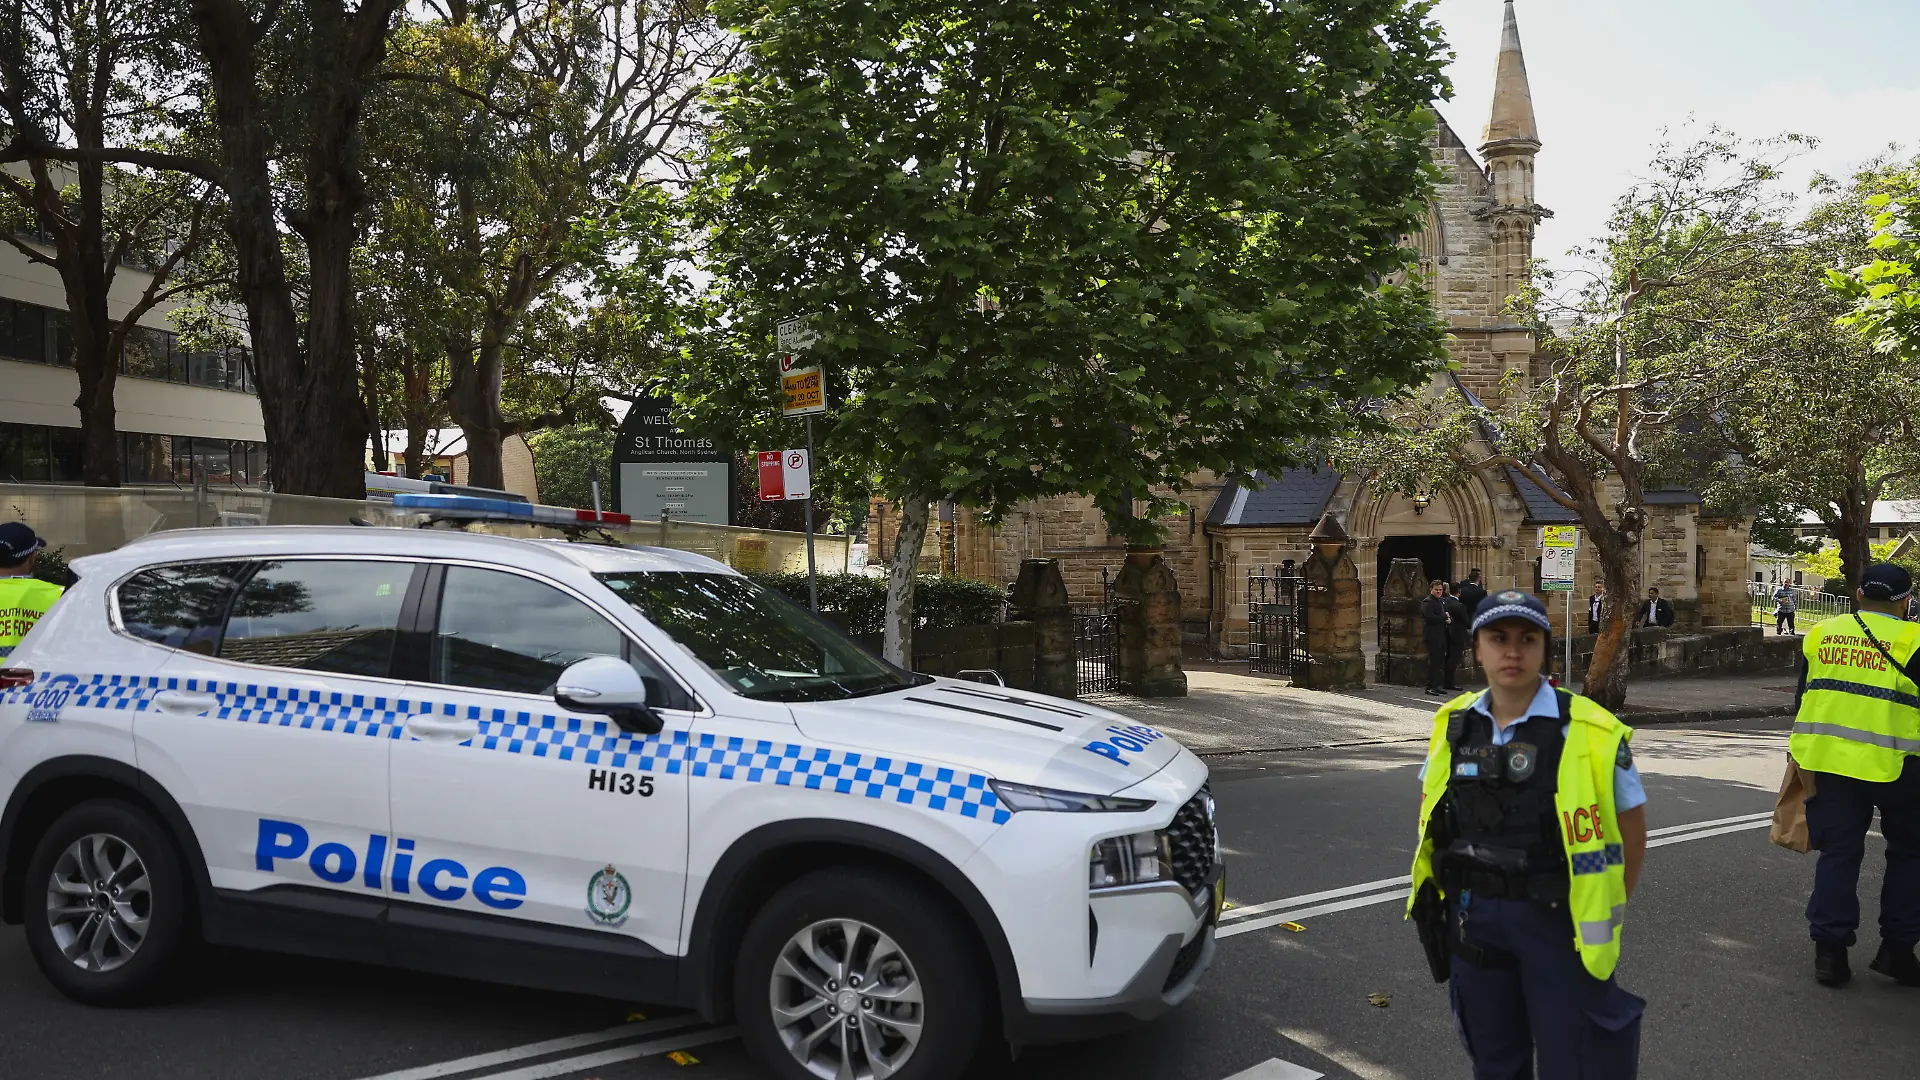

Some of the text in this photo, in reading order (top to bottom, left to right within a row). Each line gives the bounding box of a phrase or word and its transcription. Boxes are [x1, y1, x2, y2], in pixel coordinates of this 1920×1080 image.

[798, 393, 805, 401] 20
[807, 390, 820, 400] OCT
[635, 436, 713, 448] St Thomas
[1833, 634, 1860, 646] SOUTH
[1849, 648, 1888, 672] FORCE
[33, 689, 70, 710] 000
[255, 818, 527, 910] Police
